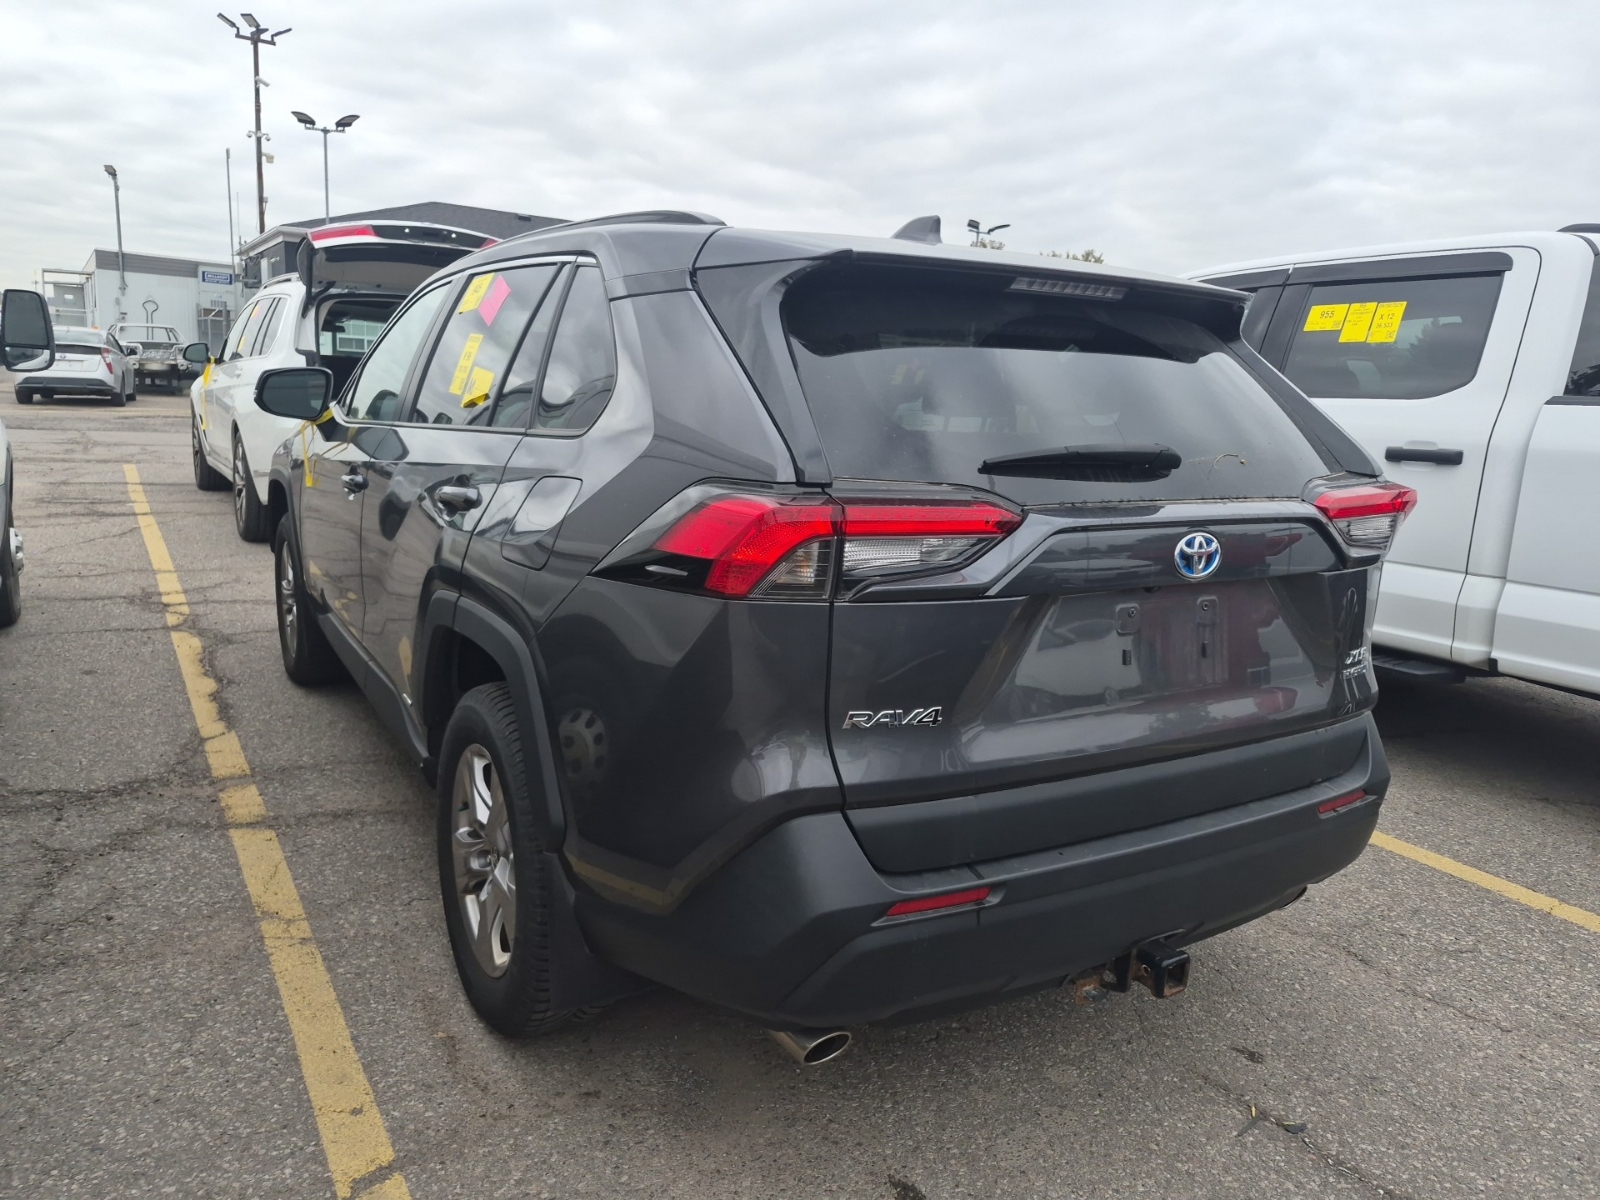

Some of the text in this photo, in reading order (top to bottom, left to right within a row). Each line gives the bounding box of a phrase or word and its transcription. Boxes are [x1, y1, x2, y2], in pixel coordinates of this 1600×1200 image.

[1320, 310, 1335, 319] 955
[1379, 312, 1395, 321] X 12
[842, 706, 942, 729] RAV4
